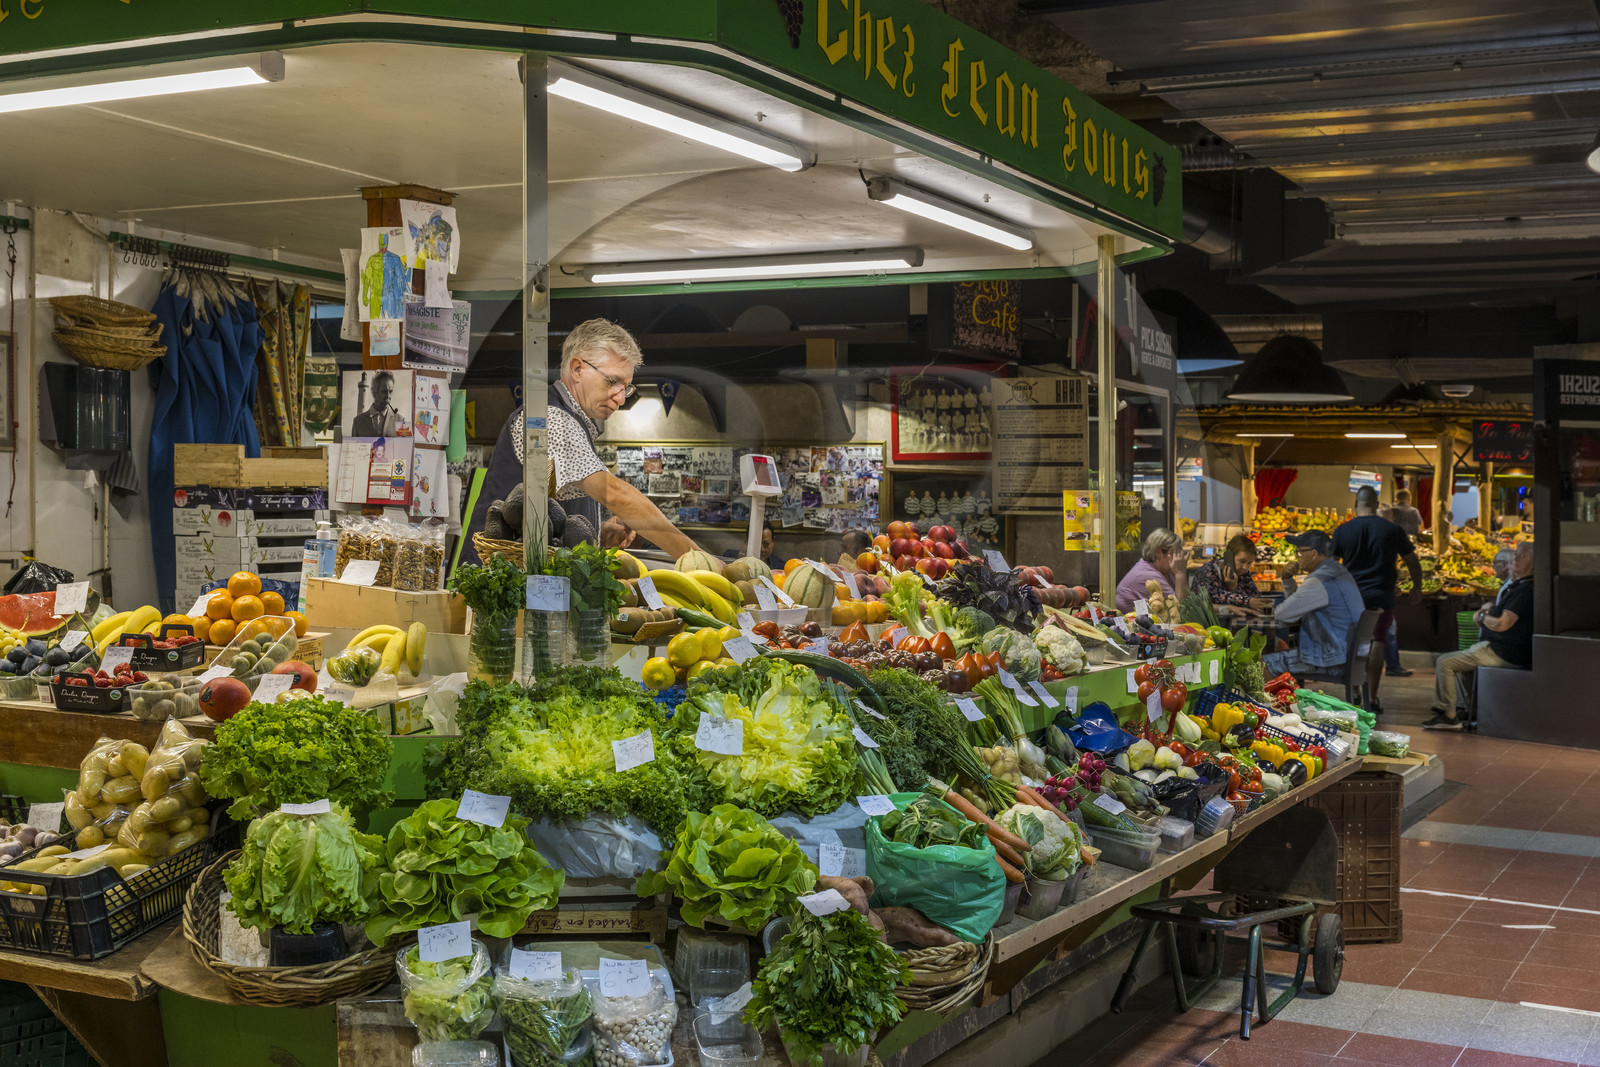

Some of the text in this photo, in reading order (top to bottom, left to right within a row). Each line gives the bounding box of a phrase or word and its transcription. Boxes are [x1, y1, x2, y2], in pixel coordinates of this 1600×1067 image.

[816, 0, 916, 99] Chez
[972, 294, 1017, 336] Café
[525, 918, 562, 932] Foli
[588, 919, 645, 931] Fraises
